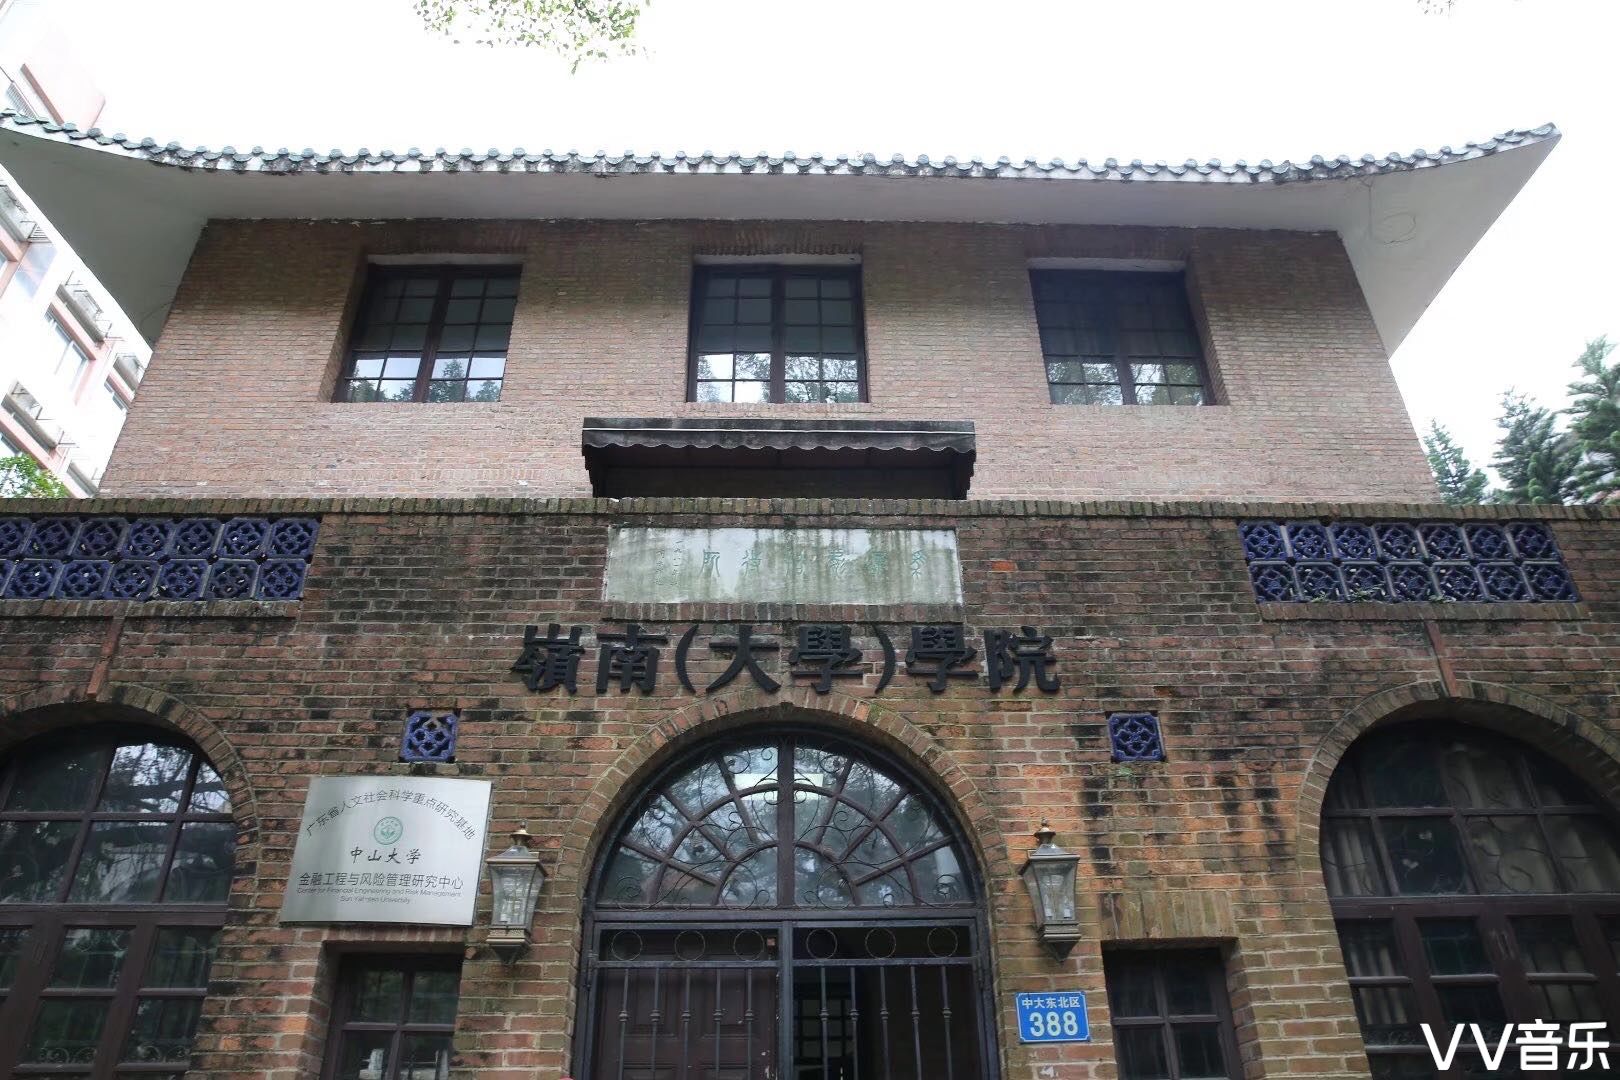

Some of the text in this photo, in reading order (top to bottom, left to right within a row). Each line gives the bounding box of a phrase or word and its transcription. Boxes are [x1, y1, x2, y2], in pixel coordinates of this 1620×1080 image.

[306, 788, 476, 841] 广东省人文社会科学重点研究基地
[350, 846, 422, 865] 中山大学
[298, 872, 464, 890] 金融工程与风险管理研究中心
[1022, 996, 1081, 1009] 中大东北区
[1029, 1011, 1078, 1037] 388
